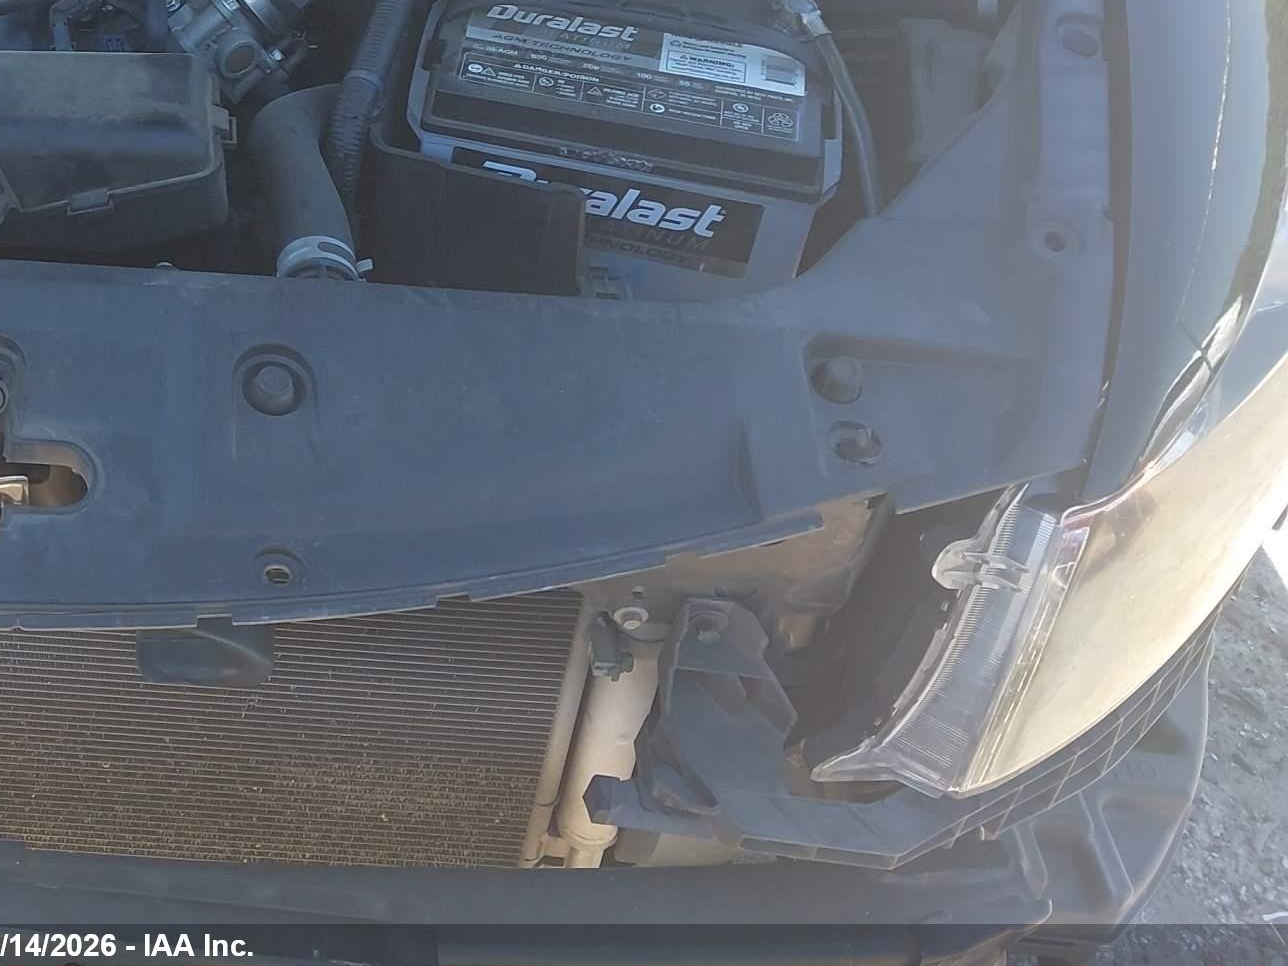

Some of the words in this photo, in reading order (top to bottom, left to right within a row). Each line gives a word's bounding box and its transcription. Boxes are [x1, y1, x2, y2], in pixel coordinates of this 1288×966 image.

[487, 4, 639, 42] Duralast
[493, 34, 528, 45] AGM
[532, 40, 633, 61] TECHNOLOGY
